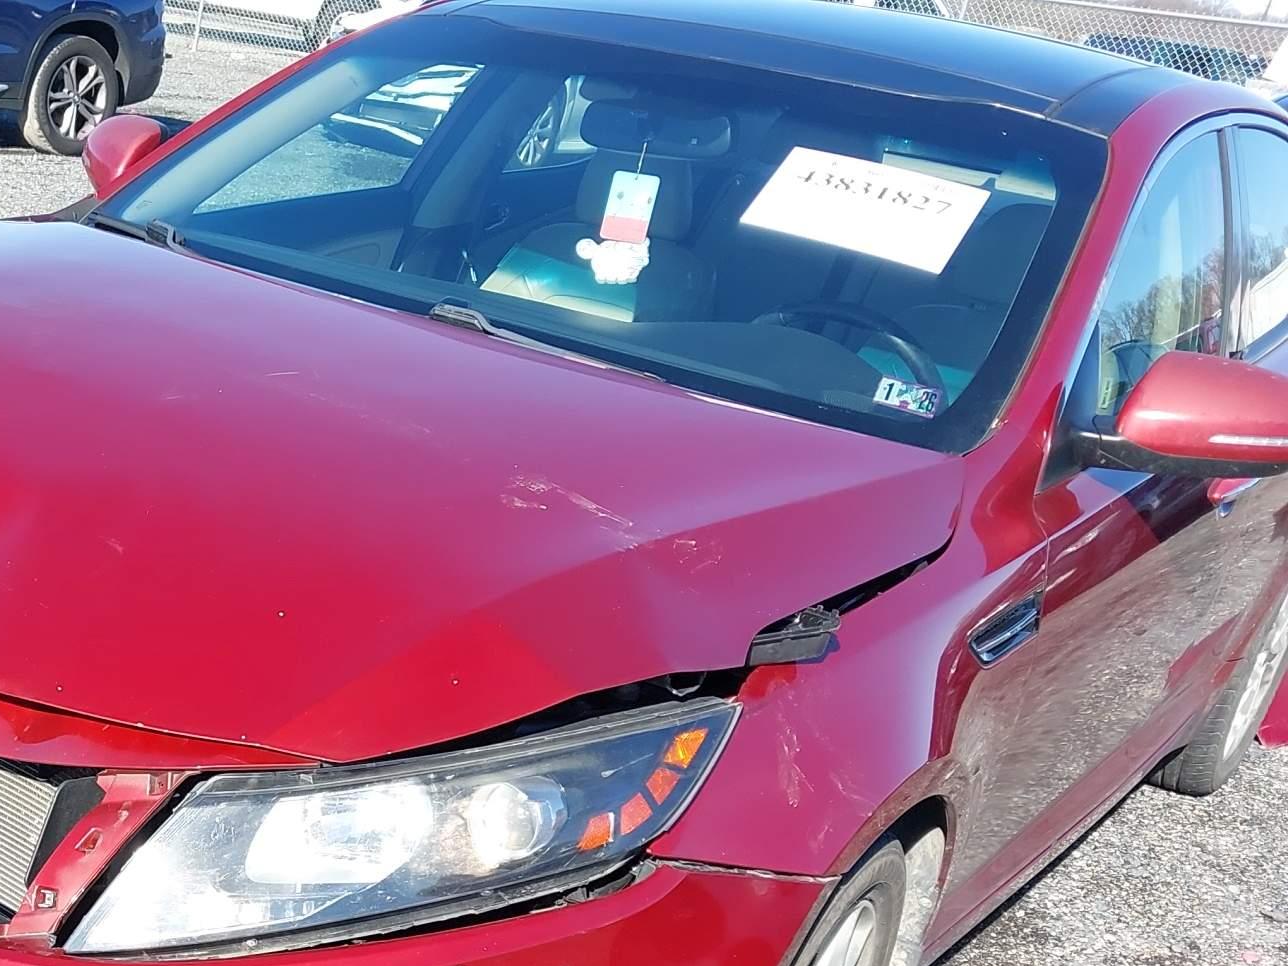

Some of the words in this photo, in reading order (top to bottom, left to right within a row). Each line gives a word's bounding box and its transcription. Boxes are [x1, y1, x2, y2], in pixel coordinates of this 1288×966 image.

[797, 170, 953, 215] 43831827
[884, 381, 896, 401] 1
[917, 390, 938, 413] 26
